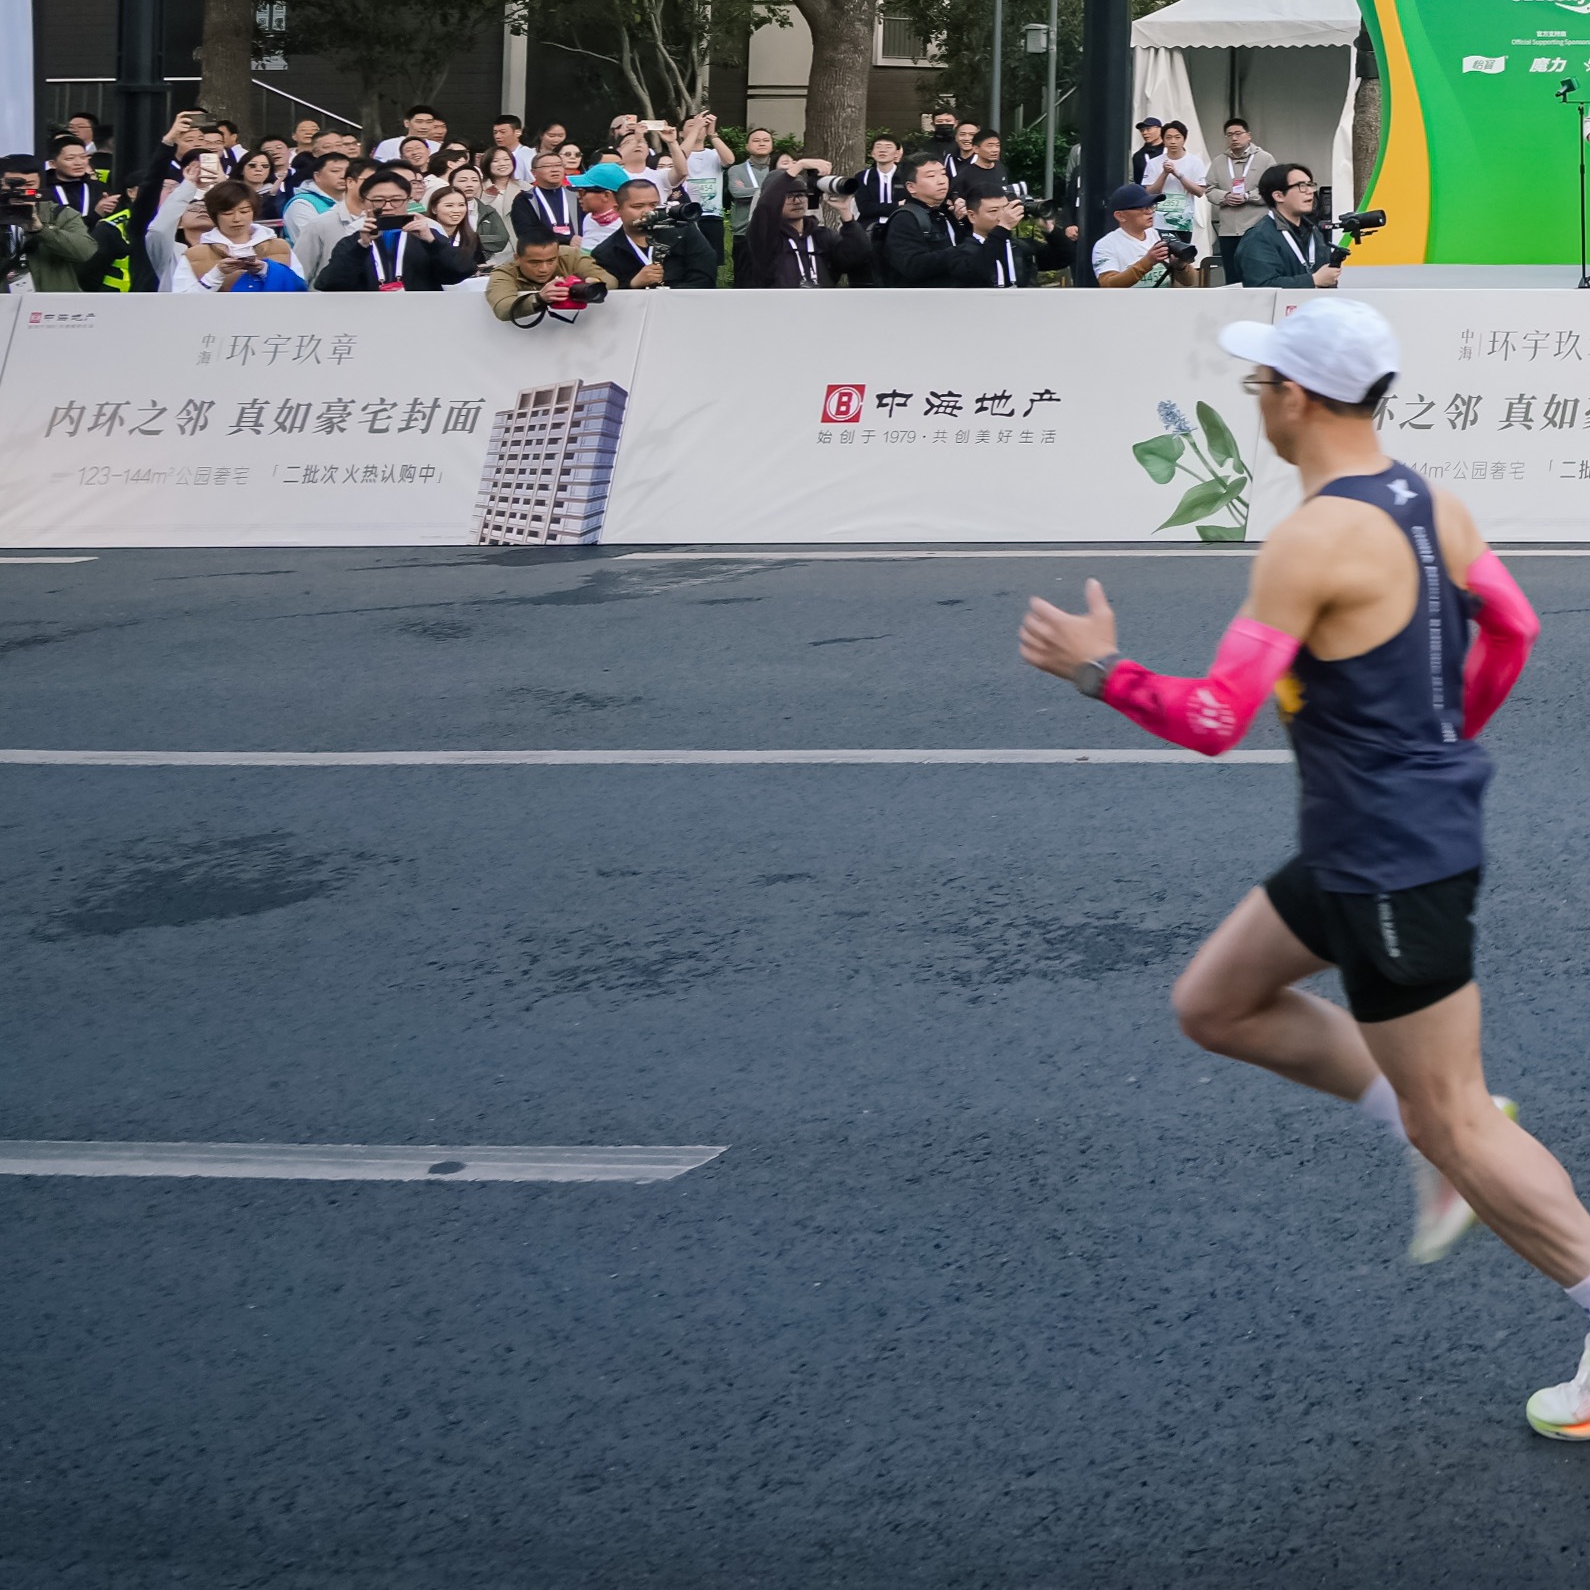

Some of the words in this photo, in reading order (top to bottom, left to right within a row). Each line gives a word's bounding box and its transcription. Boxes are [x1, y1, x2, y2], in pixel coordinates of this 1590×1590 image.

[1530, 58, 1567, 73] 魔力
[196, 333, 216, 366] 中海
[225, 333, 359, 367] 环宇玖章
[1458, 328, 1475, 362] 中海
[44, 398, 213, 439] 内环之邻
[225, 397, 486, 438] 真如豪宅封面
[874, 388, 1062, 420] 中海地产
[1372, 393, 1484, 431] 环之邻
[816, 428, 1057, 446] 始创于1979·共创美好生活
